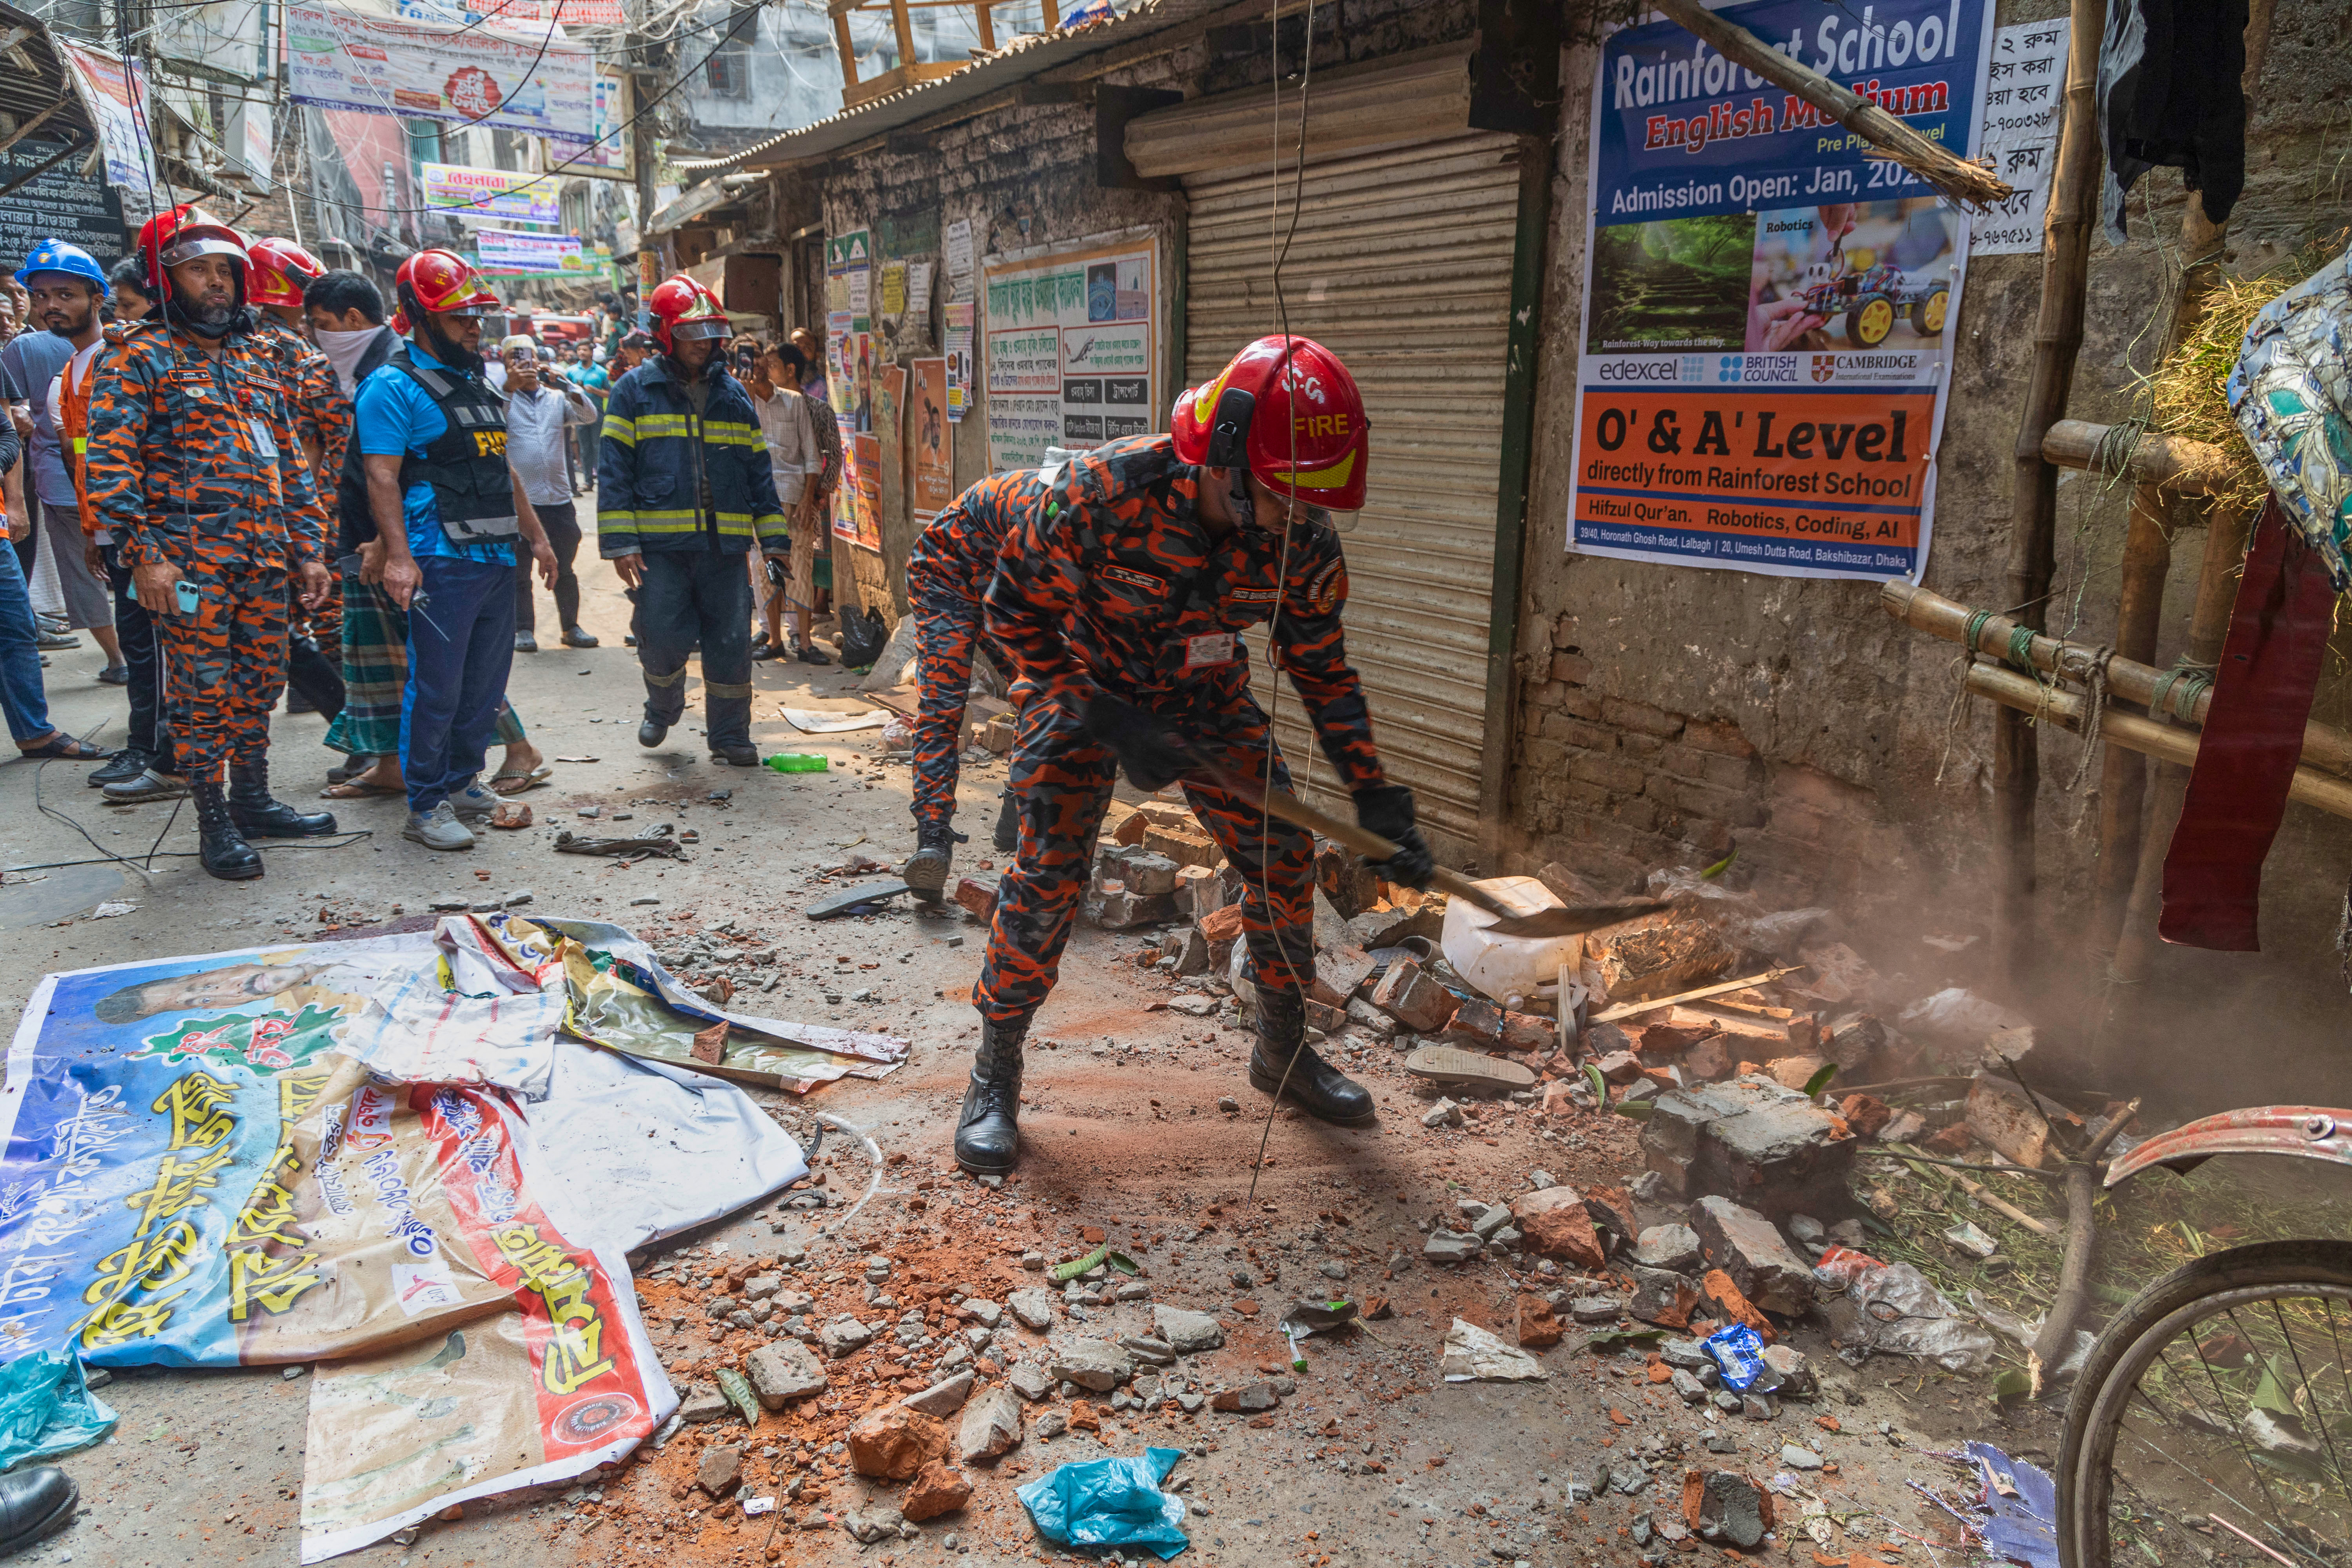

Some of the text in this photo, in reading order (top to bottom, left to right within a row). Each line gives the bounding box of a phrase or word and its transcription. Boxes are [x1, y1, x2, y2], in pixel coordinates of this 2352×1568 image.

[288, 7, 324, 25] দারুল
[1815, 2, 1957, 78] School
[2024, 30, 2061, 49] রুম
[2021, 56, 2055, 74] করা
[2018, 85, 2051, 103] হবে
[1644, 79, 1950, 153] English Meium
[1817, 136, 1842, 153] Pre
[2006, 147, 2044, 174] রুম
[21, 185, 58, 198] পাবলিক
[1611, 180, 1722, 214] Admission
[1728, 173, 1798, 209] Open:
[1804, 165, 1858, 203] Jan,
[36, 211, 80, 229] টাওয়ার
[1766, 219, 1814, 234] Robotics
[1602, 338, 1726, 349] Rainforest-Way towards the sky.
[998, 358, 1015, 371] দিনের
[1035, 359, 1057, 371] প্যাকেজ
[1599, 357, 1678, 381] edexcel
[1746, 355, 1797, 370] BRITISH
[1835, 355, 1917, 370] CAMBRIDGE
[1744, 368, 1798, 382] COUNCIL
[1835, 372, 1916, 381] International Examinations
[1084, 383, 1095, 397] ভিসা
[1022, 417, 1043, 431] যোগাযোগ
[1294, 414, 1350, 439] FIRE
[1647, 409, 1682, 456] &
[1753, 410, 1908, 463] Level
[1587, 459, 1911, 499] directly from Rainforest School
[1588, 499, 1632, 519] Hifzul
[1707, 509, 1791, 533] Robotics,
[1795, 515, 1871, 541] Coding,
[1601, 528, 1632, 542] Horonath
[1633, 531, 1657, 545] Ghosh
[1658, 533, 1679, 548] Road,
[1681, 535, 1711, 552] Lalbagh
[1722, 540, 1733, 554] 20,
[1735, 541, 1762, 555] Umesh
[1764, 544, 1788, 557] Dutta
[1789, 546, 1814, 562] Road,
[1816, 548, 1874, 568] Bakshibazar,
[1876, 553, 1907, 568] Dhaka
[355, 1085, 383, 1128] নগদ
[315, 1104, 354, 1216] যোগাযোগ করুন
